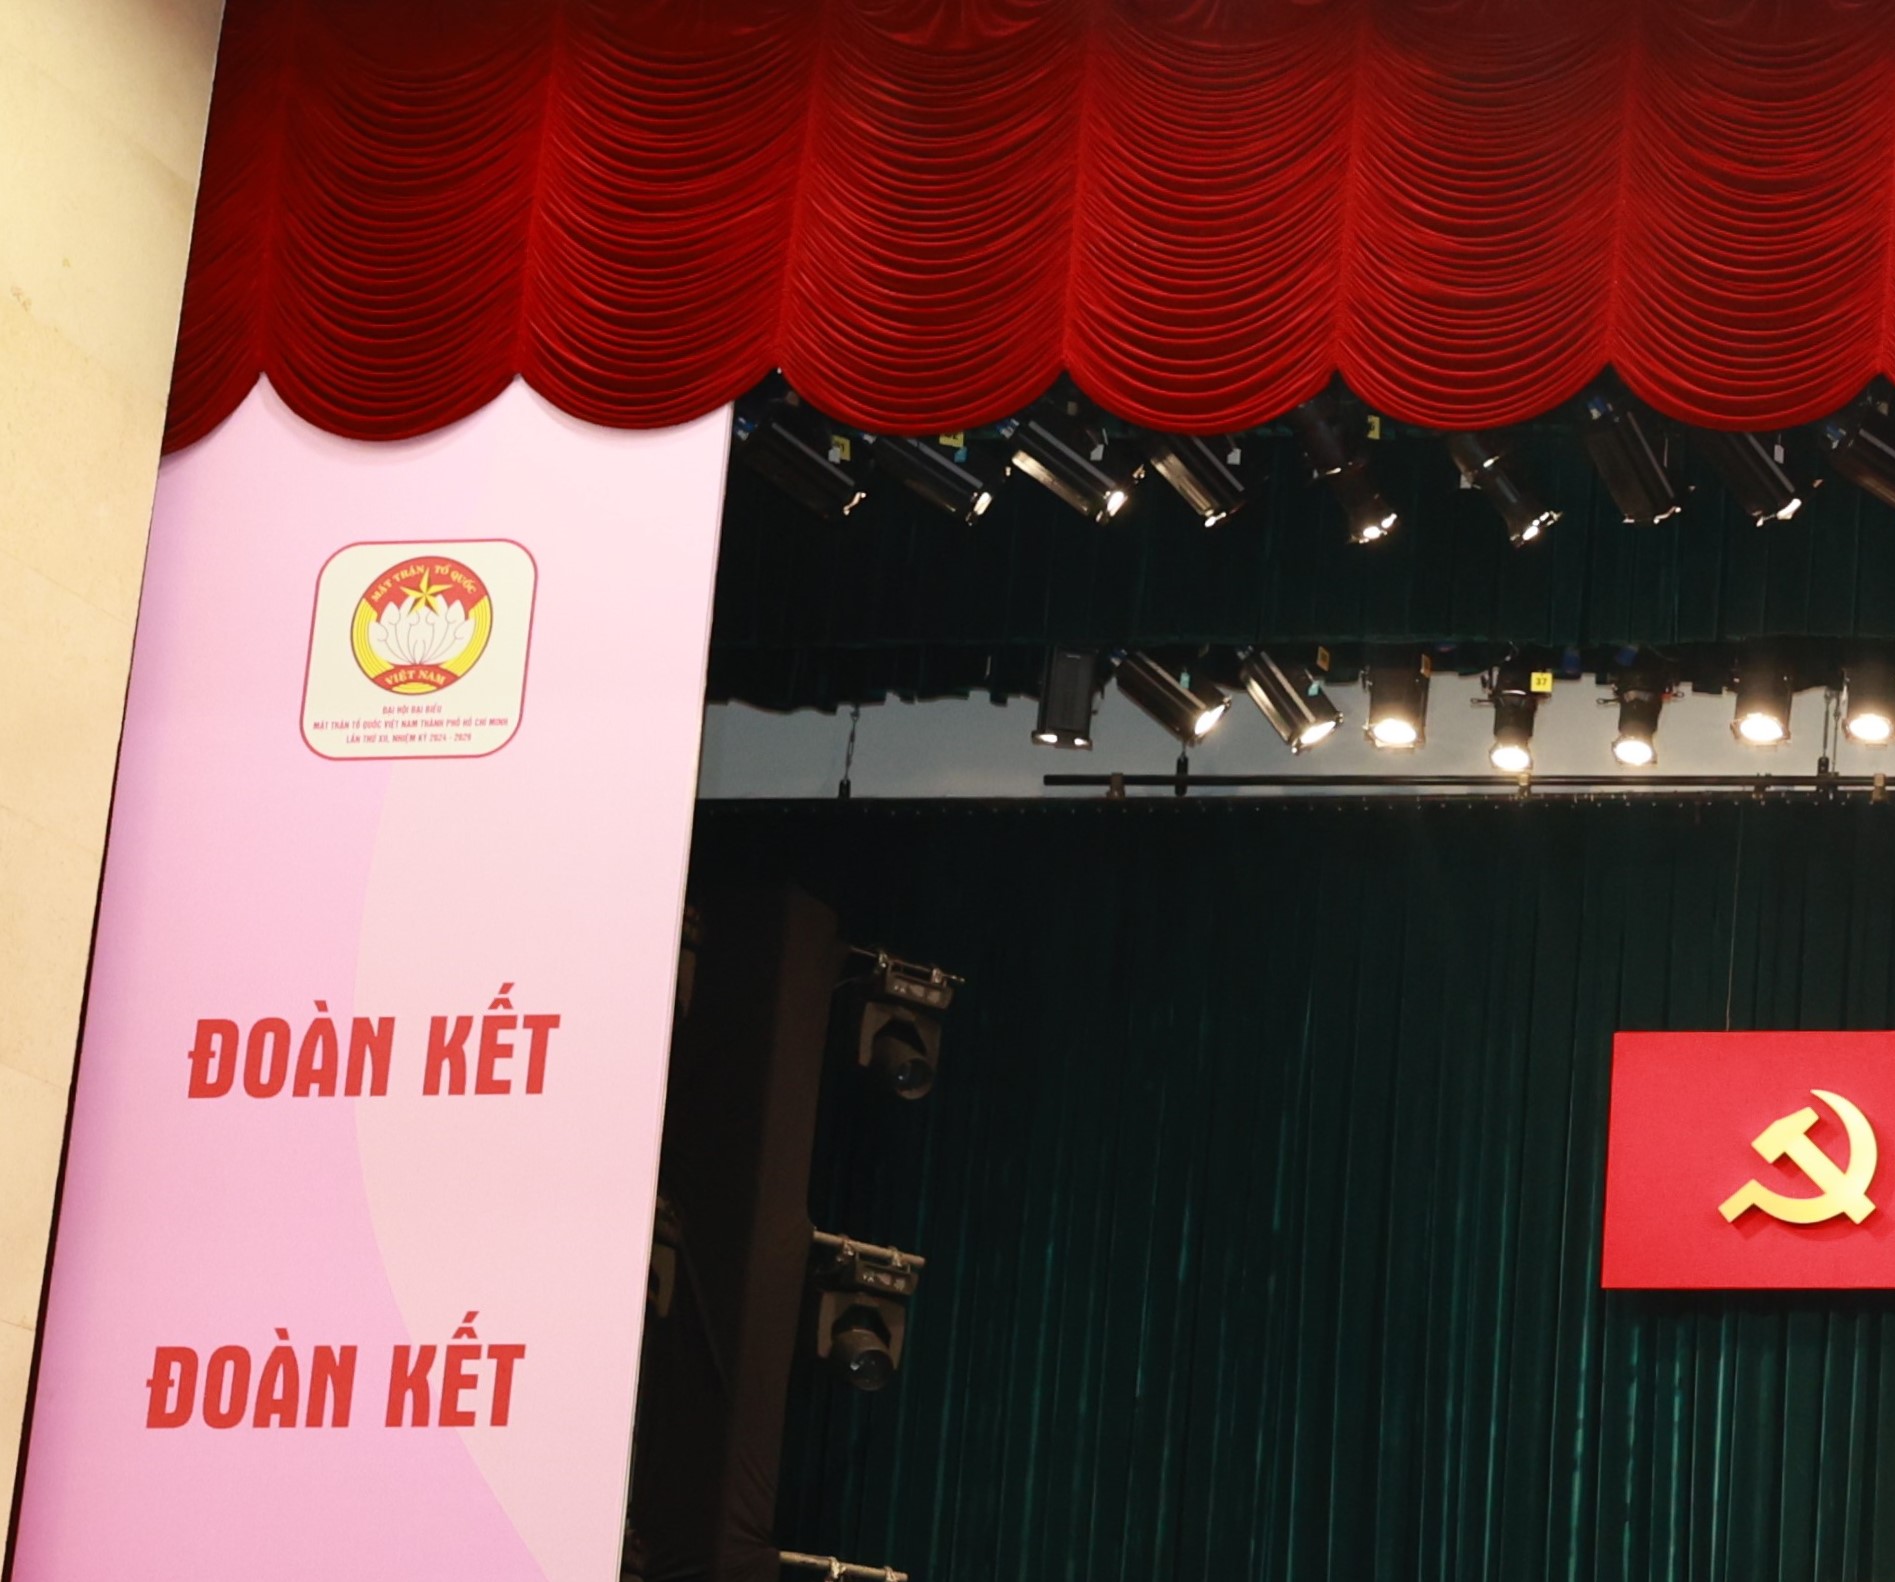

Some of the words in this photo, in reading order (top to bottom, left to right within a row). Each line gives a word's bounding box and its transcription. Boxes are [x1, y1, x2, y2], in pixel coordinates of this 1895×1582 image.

[188, 1000, 395, 1098] ĐOÀN
[423, 983, 560, 1095] KẾT
[146, 1327, 358, 1429] ĐOÀN
[385, 1311, 526, 1428] KẾT
